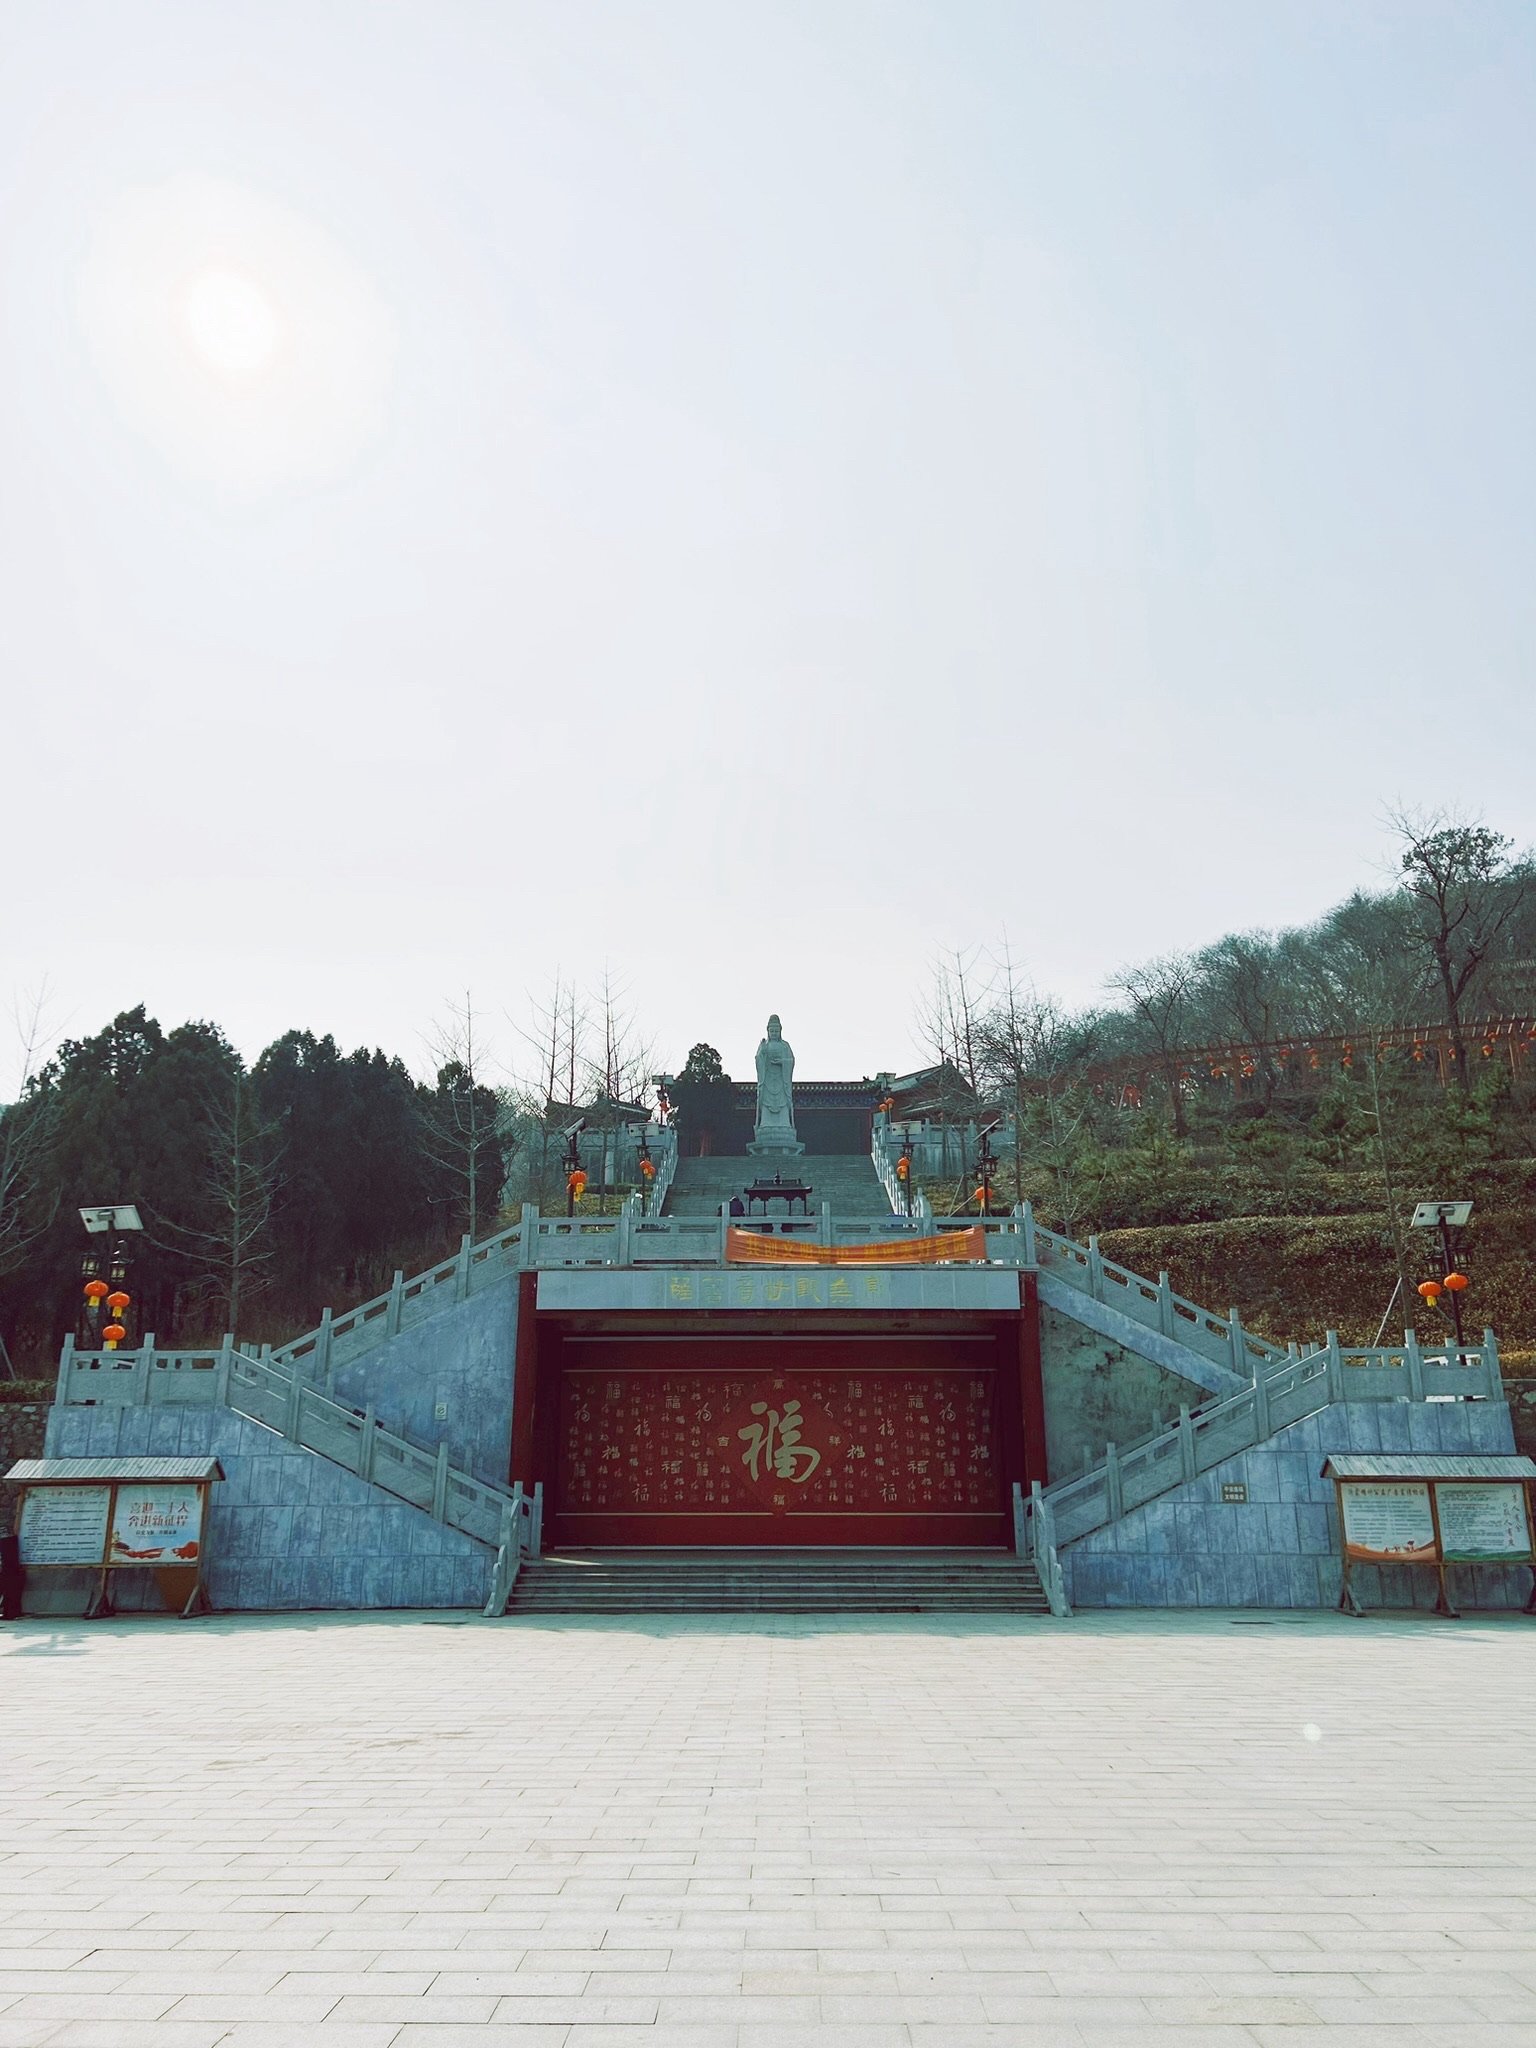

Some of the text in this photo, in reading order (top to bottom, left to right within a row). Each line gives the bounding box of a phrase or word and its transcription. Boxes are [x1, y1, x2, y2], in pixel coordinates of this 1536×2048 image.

[717, 1437, 730, 1446] 吉
[738, 1400, 820, 1482] 福
[828, 1436, 841, 1446] 祥
[773, 1494, 785, 1505] 福
